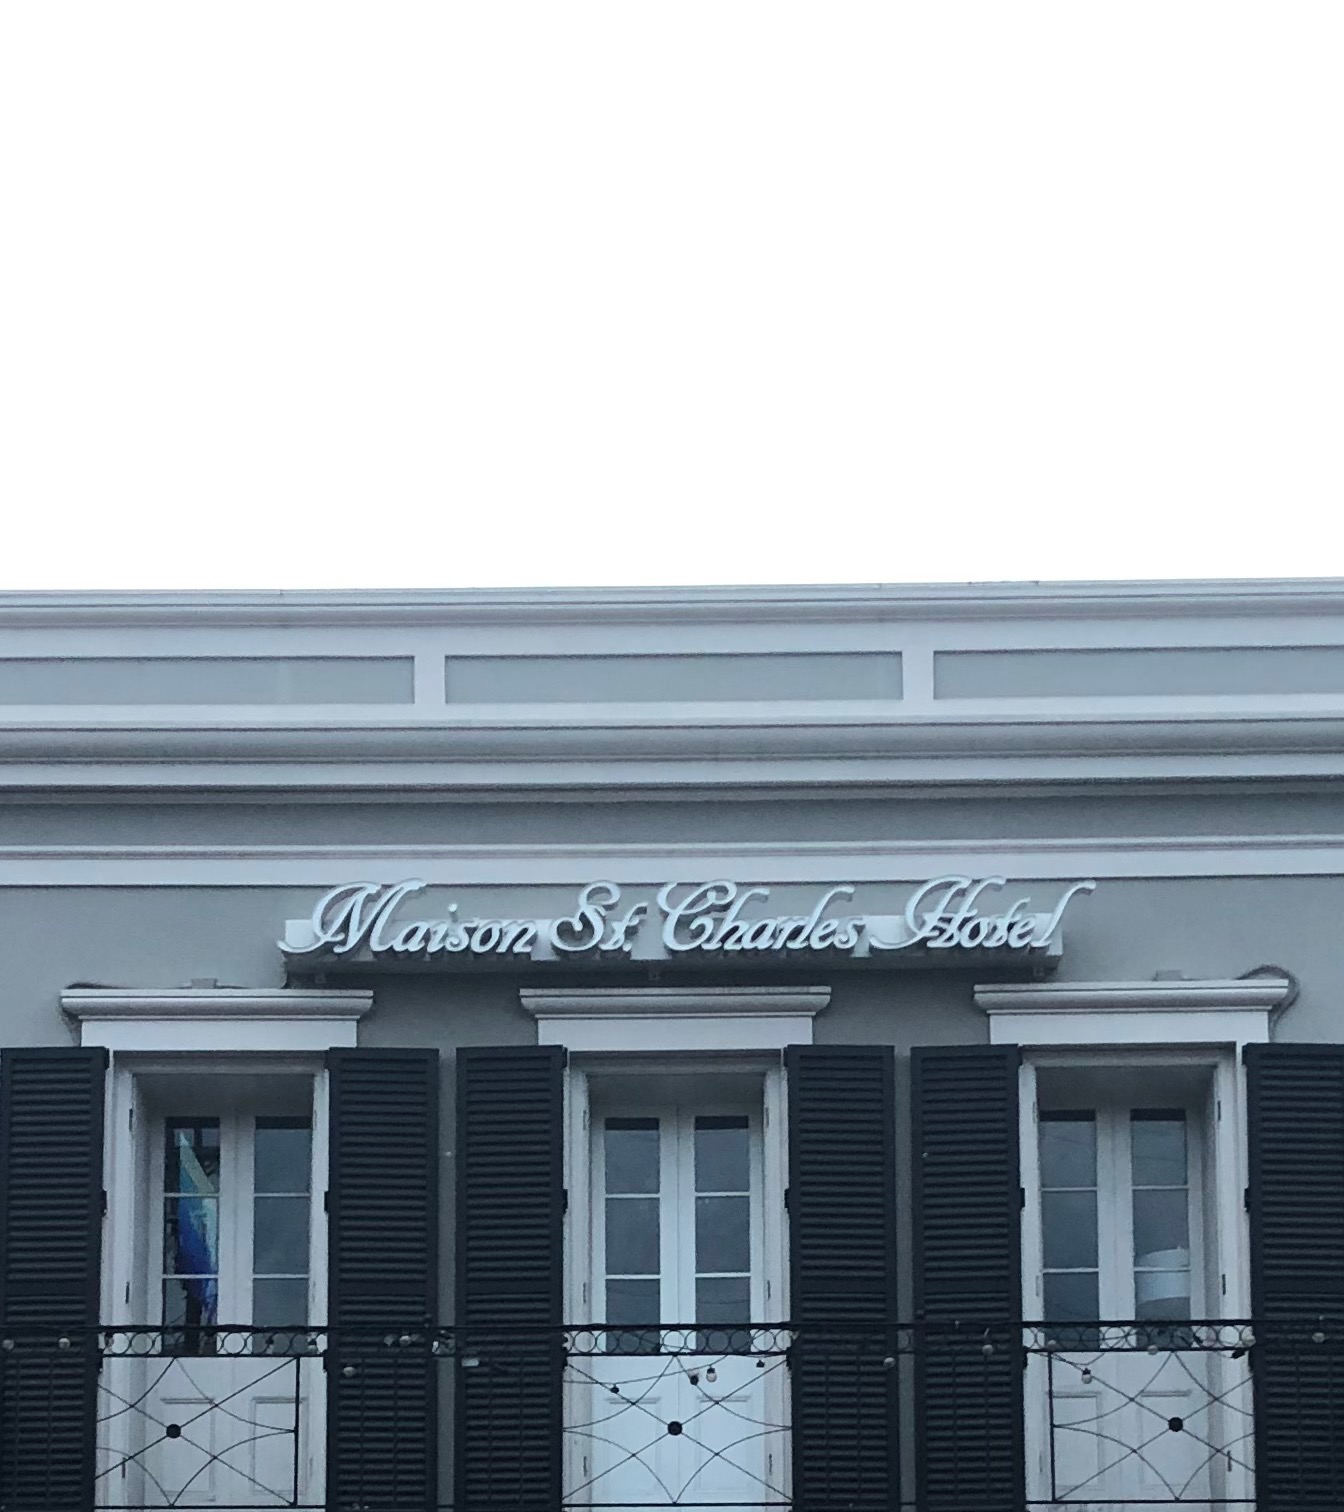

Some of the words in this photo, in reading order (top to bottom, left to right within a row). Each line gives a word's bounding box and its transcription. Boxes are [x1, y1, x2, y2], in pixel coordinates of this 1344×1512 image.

[277, 877, 538, 954] Maison
[551, 880, 649, 953] St.
[657, 879, 866, 952] Charles
[869, 874, 1096, 950] Hotel
